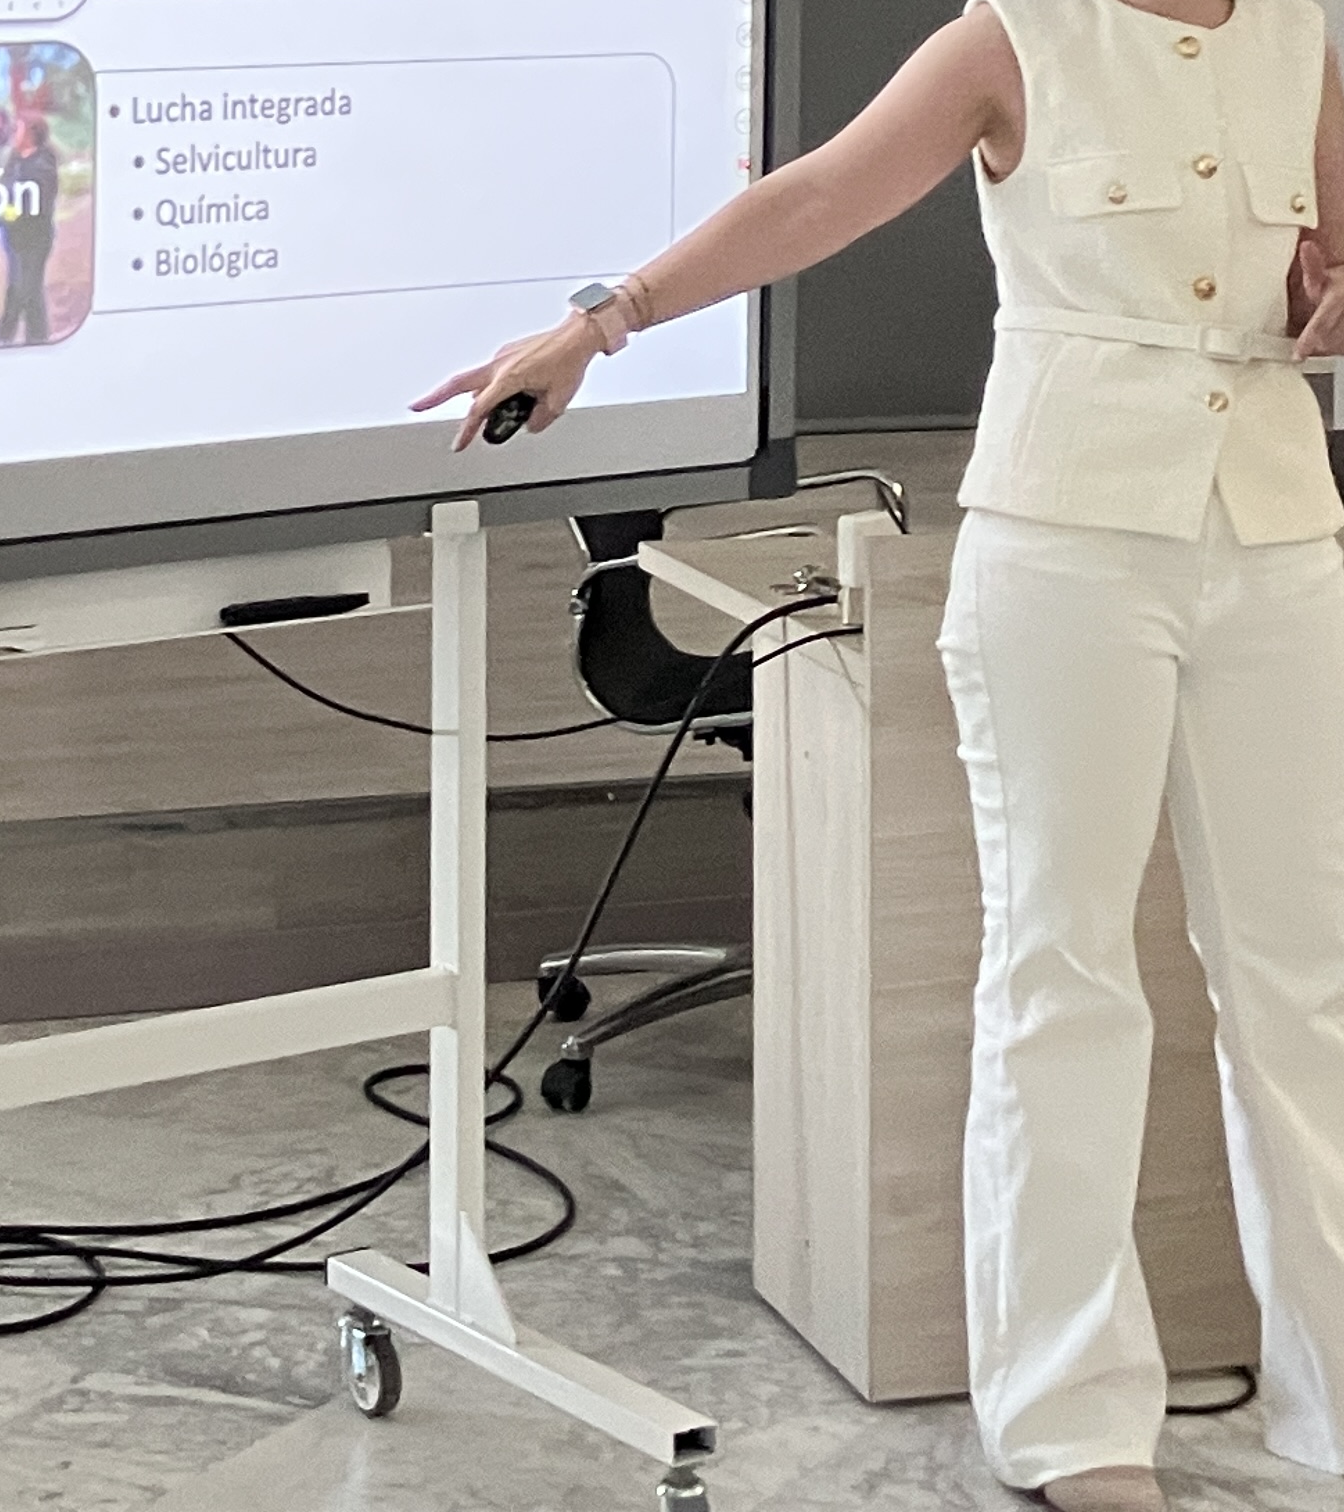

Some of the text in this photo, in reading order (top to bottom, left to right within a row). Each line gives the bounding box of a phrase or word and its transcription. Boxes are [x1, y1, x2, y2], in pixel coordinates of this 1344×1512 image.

[131, 89, 353, 129] Lucha integrada
[155, 142, 319, 176] Selvicultura
[155, 194, 271, 231] Química
[155, 243, 280, 282] Biológica
